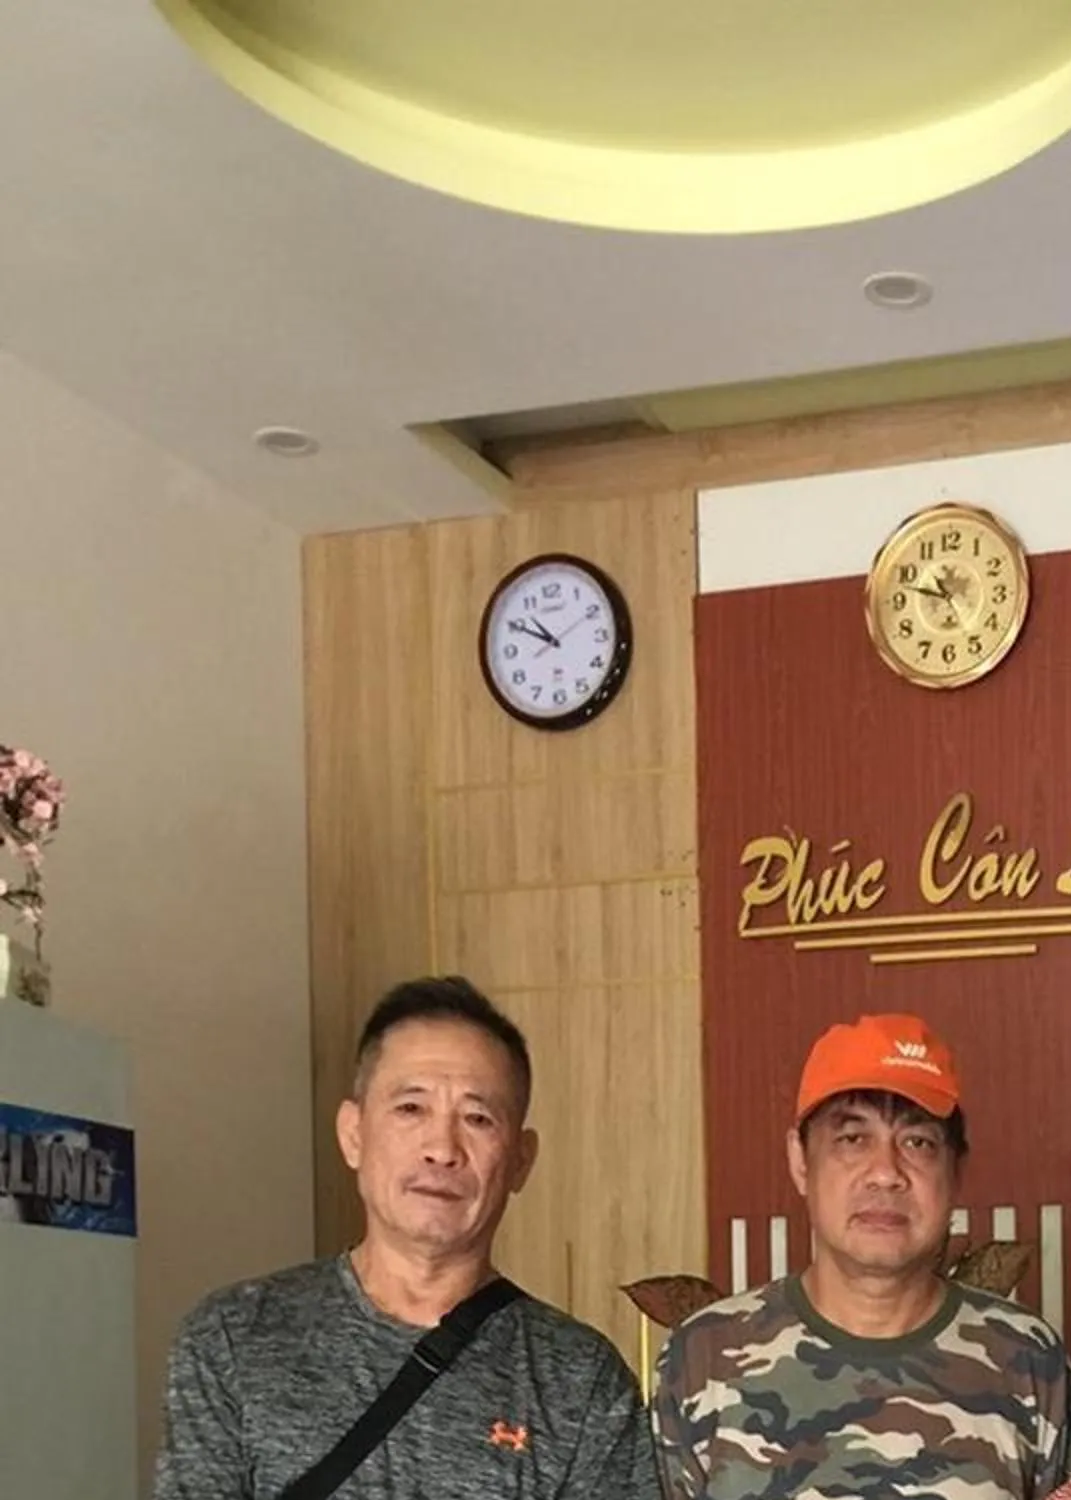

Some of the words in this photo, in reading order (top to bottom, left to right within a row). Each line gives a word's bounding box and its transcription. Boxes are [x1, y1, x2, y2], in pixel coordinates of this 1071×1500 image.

[919, 541, 935, 560] 11
[940, 531, 962, 552] 12
[898, 564, 918, 584] 10
[987, 558, 1001, 577] 2
[541, 583, 561, 599] 12
[992, 585, 1006, 604] 3
[523, 597, 537, 610] 11
[892, 592, 906, 610] 9
[586, 605, 600, 620] 2
[899, 619, 913, 638] 8
[984, 613, 998, 632] 4
[594, 628, 608, 643] 3
[967, 635, 982, 654] 5
[503, 644, 518, 659] 9
[917, 641, 932, 660] 7
[942, 644, 956, 664] 6
[590, 655, 603, 669] 4
[512, 670, 526, 685] 8
[575, 678, 590, 694] 5
[530, 685, 543, 702] 7
[552, 689, 567, 705] 6
[740, 831, 885, 931] Phúc
[919, 792, 1040, 905] Côn
